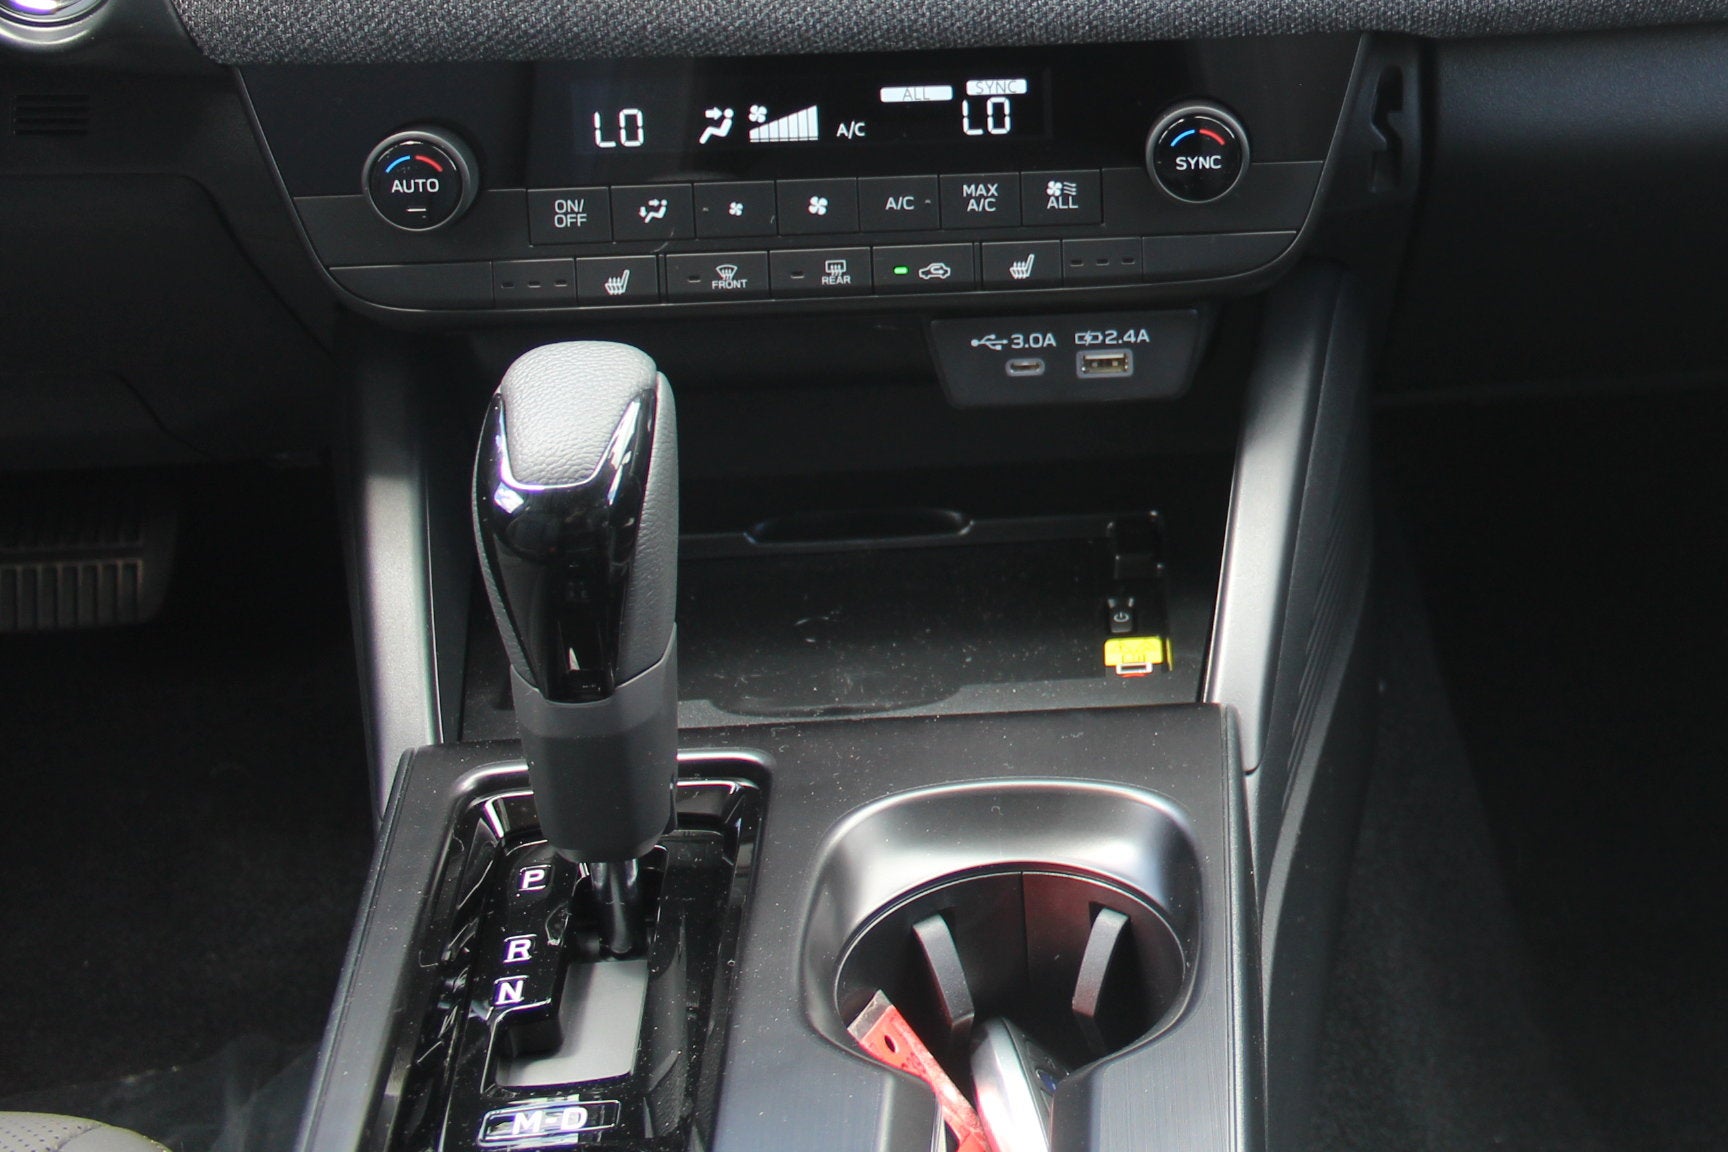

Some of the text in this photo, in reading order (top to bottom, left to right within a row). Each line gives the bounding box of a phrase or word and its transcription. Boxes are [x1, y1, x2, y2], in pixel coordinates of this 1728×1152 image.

[903, 87, 930, 101] ALL
[976, 80, 1017, 95] SYNC
[836, 122, 865, 138] A/C
[1175, 156, 1222, 171] SYNC
[391, 178, 439, 193] AUTO
[963, 184, 998, 197] MAX
[554, 199, 584, 213] ON/
[885, 196, 915, 211] A/C
[967, 198, 996, 212] A/C
[1047, 195, 1078, 209] ALL
[554, 214, 587, 228] OFF
[711, 278, 748, 290] FRONT
[821, 275, 851, 285] REAR
[1011, 333, 1056, 348] 3.0A
[1105, 329, 1150, 345] 2.4A
[521, 868, 546, 888] P
[506, 938, 532, 960] R
[495, 980, 525, 1005] N
